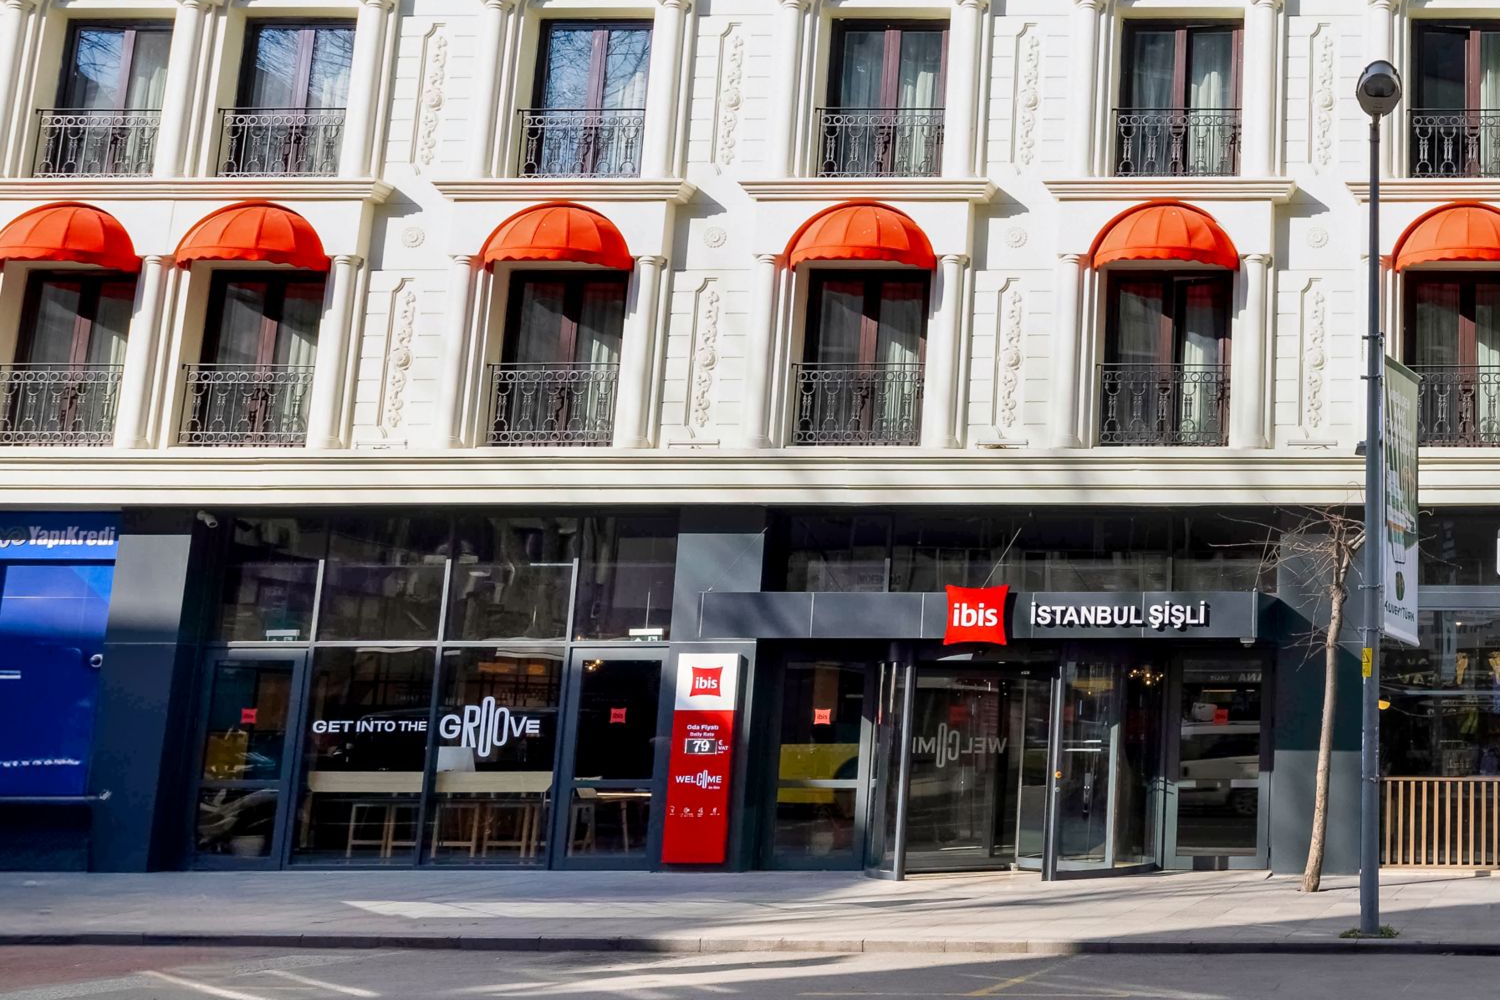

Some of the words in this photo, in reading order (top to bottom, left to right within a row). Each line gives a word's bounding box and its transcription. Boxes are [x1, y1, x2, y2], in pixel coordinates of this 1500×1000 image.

[28, 526, 116, 549] YapıKredi
[953, 602, 998, 627] ibis
[1030, 601, 1143, 625] İSTANBUL
[1149, 600, 1205, 628] ŞİŞLİ
[695, 676, 718, 689] ibis
[312, 720, 353, 733] GET
[355, 720, 396, 732] INTO
[398, 720, 428, 732] THE
[439, 696, 541, 757] GROOVE
[692, 740, 710, 753] 79
[675, 769, 722, 789] WELCOME
